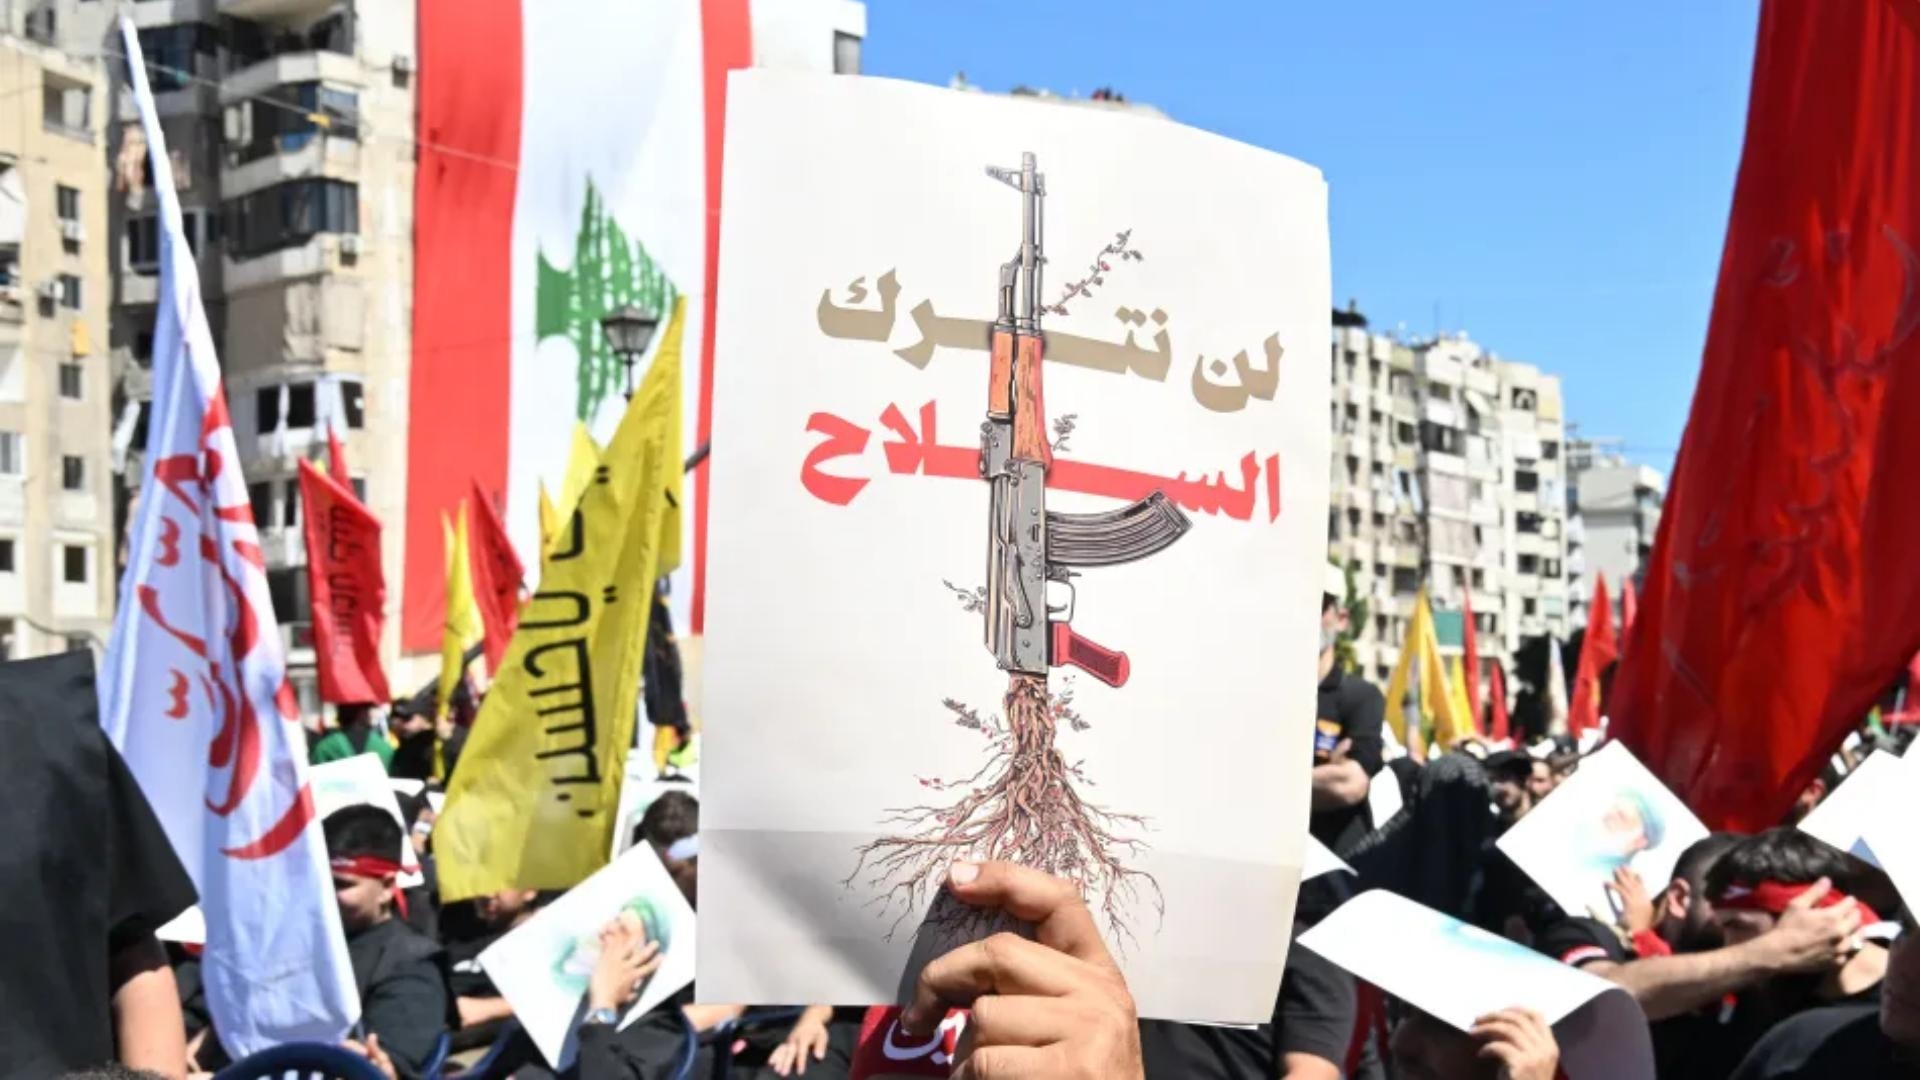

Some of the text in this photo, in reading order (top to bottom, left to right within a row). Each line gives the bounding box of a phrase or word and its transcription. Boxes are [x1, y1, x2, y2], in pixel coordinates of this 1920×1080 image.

[817, 267, 1284, 413] لن نترك
[800, 400, 1281, 524] السلاح
